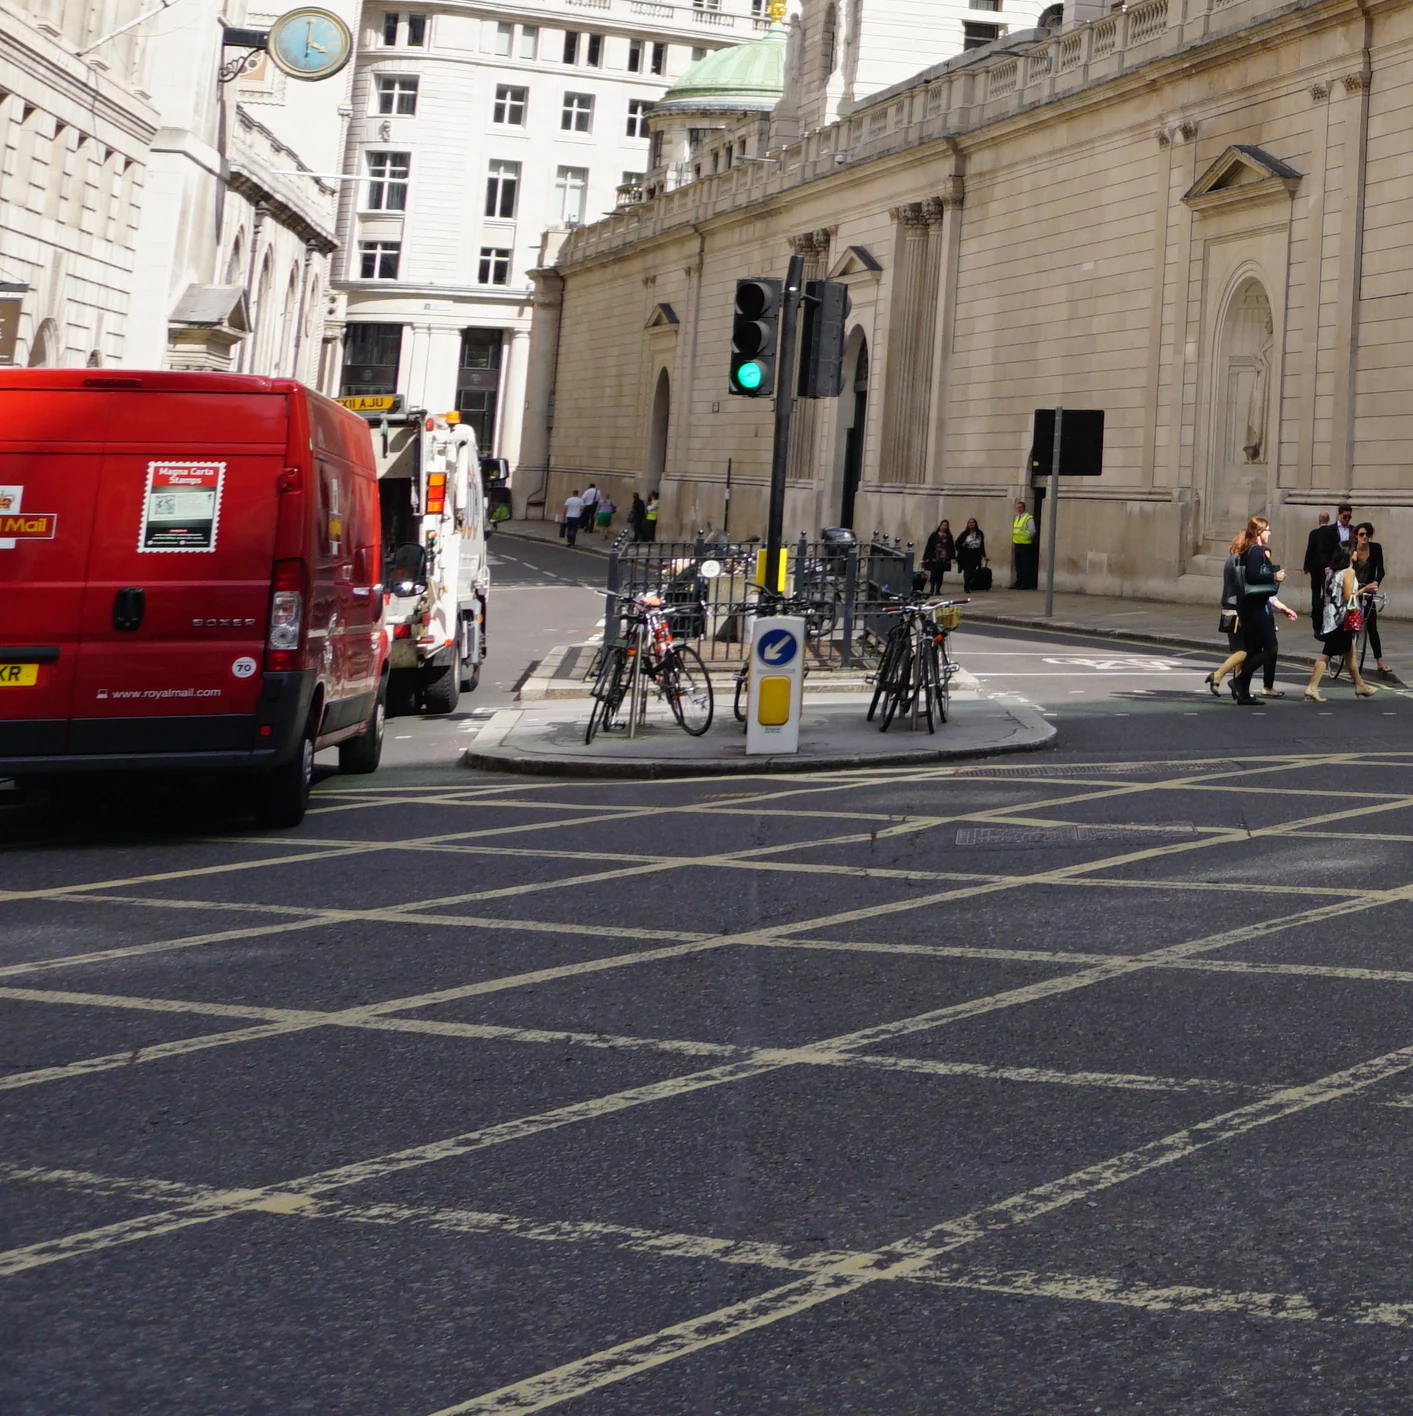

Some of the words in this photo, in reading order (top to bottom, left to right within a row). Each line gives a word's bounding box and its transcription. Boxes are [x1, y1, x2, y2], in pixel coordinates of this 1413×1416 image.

[159, 467, 188, 477] Magna
[190, 467, 214, 476] Carta
[168, 476, 203, 485] Stamps
[4, 517, 47, 532] Mail
[192, 618, 256, 627] BOXER
[237, 664, 252, 672] 70
[111, 688, 222, 700] www.royalmail.com
